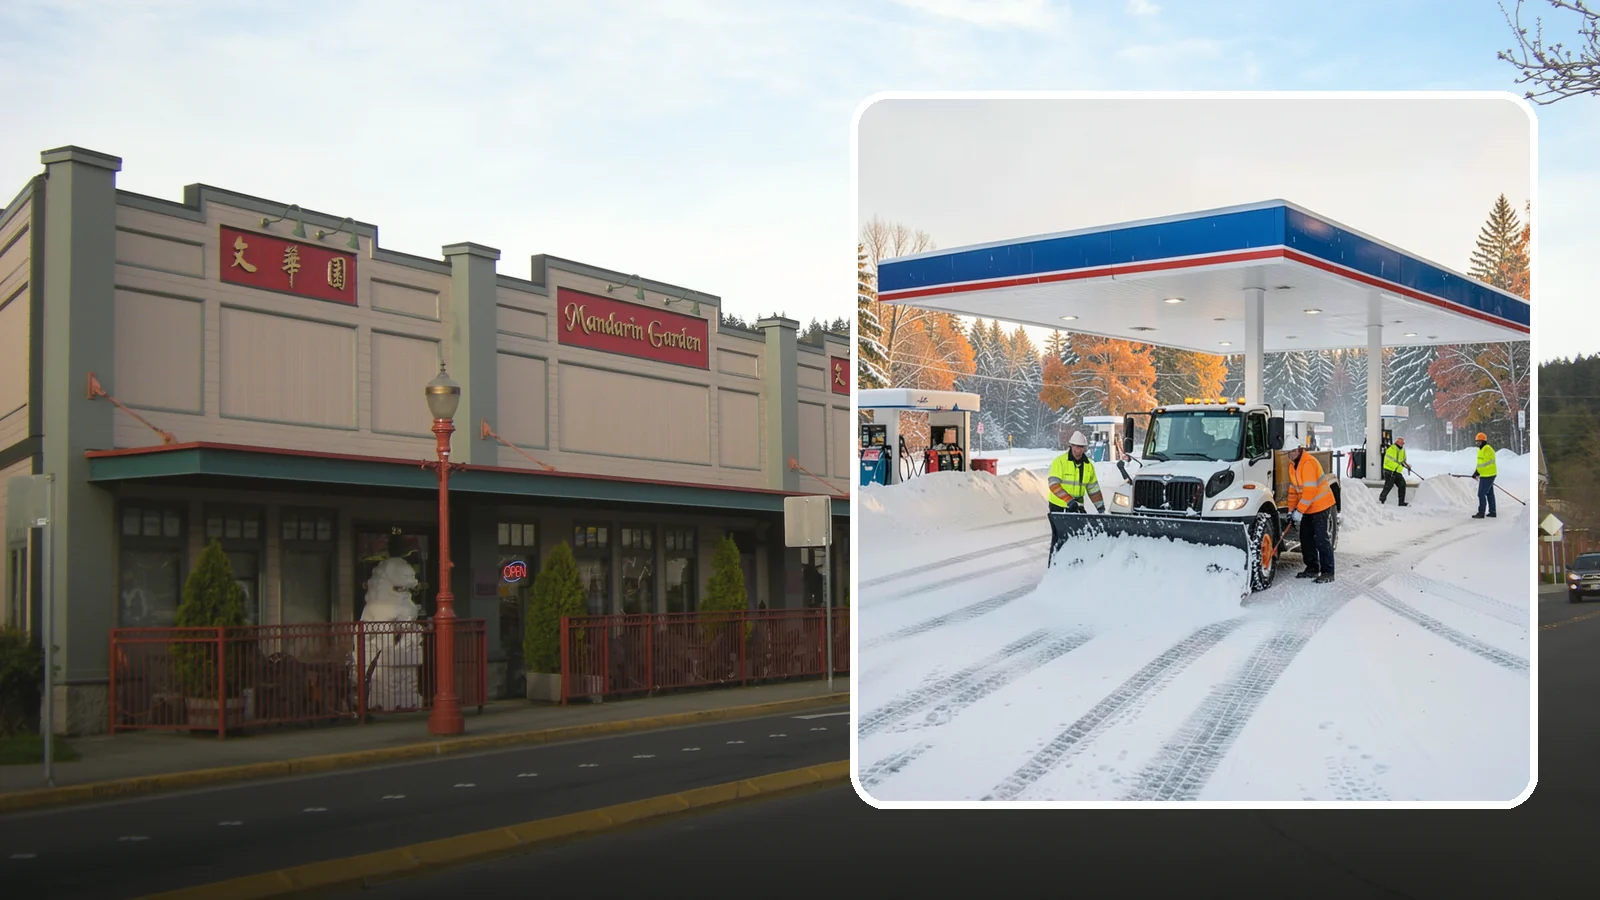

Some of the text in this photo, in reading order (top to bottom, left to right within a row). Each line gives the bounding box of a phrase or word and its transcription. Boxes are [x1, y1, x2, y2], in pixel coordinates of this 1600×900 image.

[231, 236, 346, 291] 文華園
[564, 302, 702, 352] Mandarin Garden
[503, 565, 527, 578] OPEN
